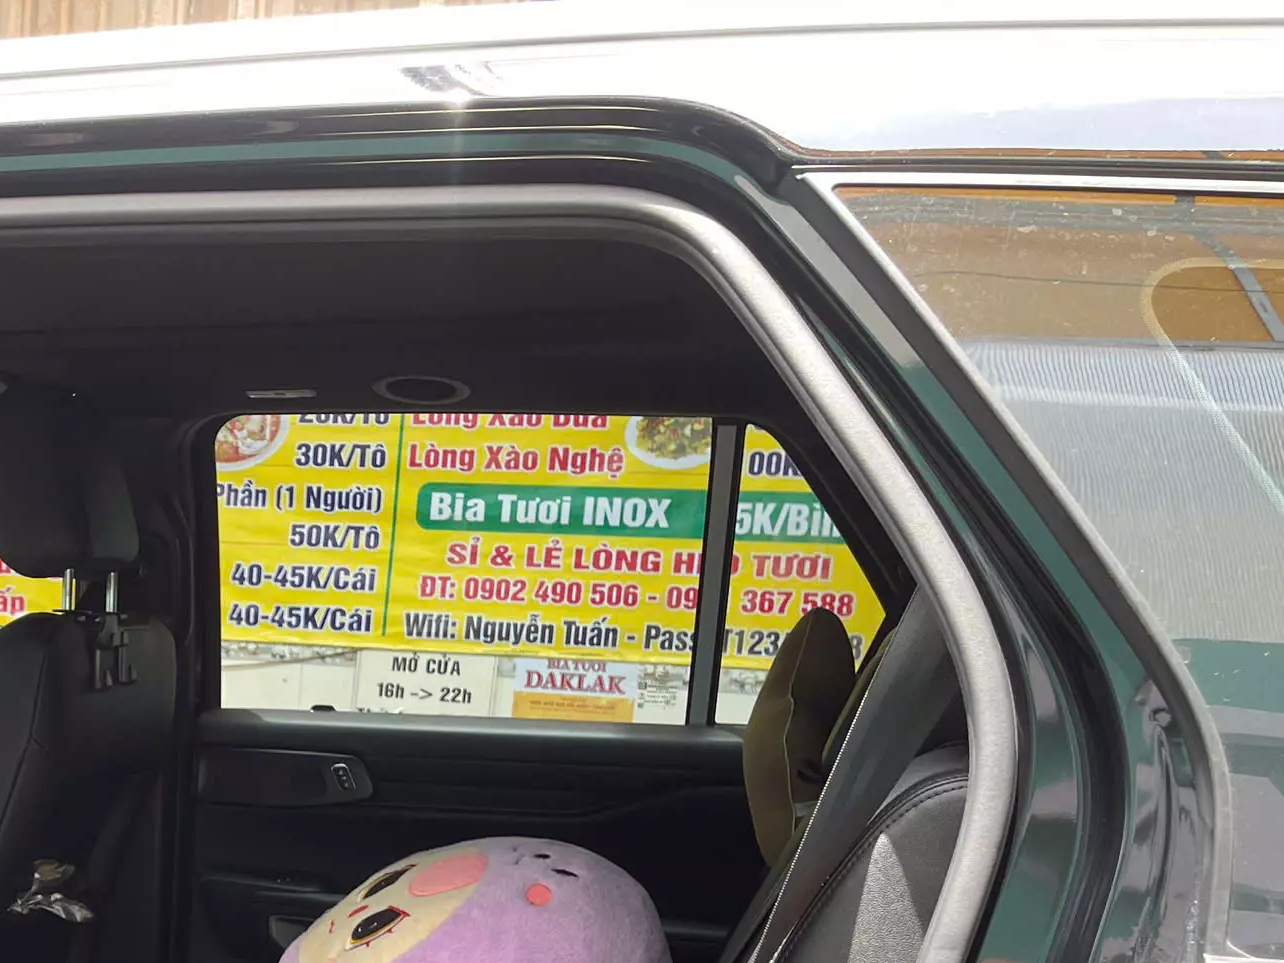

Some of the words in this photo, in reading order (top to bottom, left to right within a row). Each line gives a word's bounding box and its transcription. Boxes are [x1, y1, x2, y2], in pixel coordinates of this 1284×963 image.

[296, 443, 386, 468] 30K/Tô
[408, 443, 475, 472] Lòng
[484, 445, 540, 472] Xào
[548, 447, 624, 478] Nghệ
[306, 485, 383, 514] Người)
[430, 491, 486, 522] Bia
[497, 493, 572, 526] Tươi
[583, 496, 672, 528] INOX
[289, 523, 380, 550] 50K/Tô
[447, 536, 481, 567] SỈ
[490, 545, 514, 568] &
[526, 538, 563, 570] LẺ
[573, 543, 662, 574] LÒNG
[753, 553, 832, 580] TƯƠI
[232, 563, 376, 592] 40-45K/Cái
[420, 575, 456, 600] ĐT:
[464, 577, 527, 602] 0902
[534, 580, 583, 604] 490
[590, 583, 639, 608] 506
[741, 590, 793, 615] 367
[229, 603, 373, 632] 40-45K/Cái
[405, 612, 457, 639] Wifi:
[465, 614, 555, 645] Nguyễn
[564, 617, 618, 648] Tuấn
[426, 653, 462, 676] CỬA
[377, 682, 405, 699] 16h
[439, 686, 473, 704] 22h
[524, 670, 628, 695] DAKLAK
